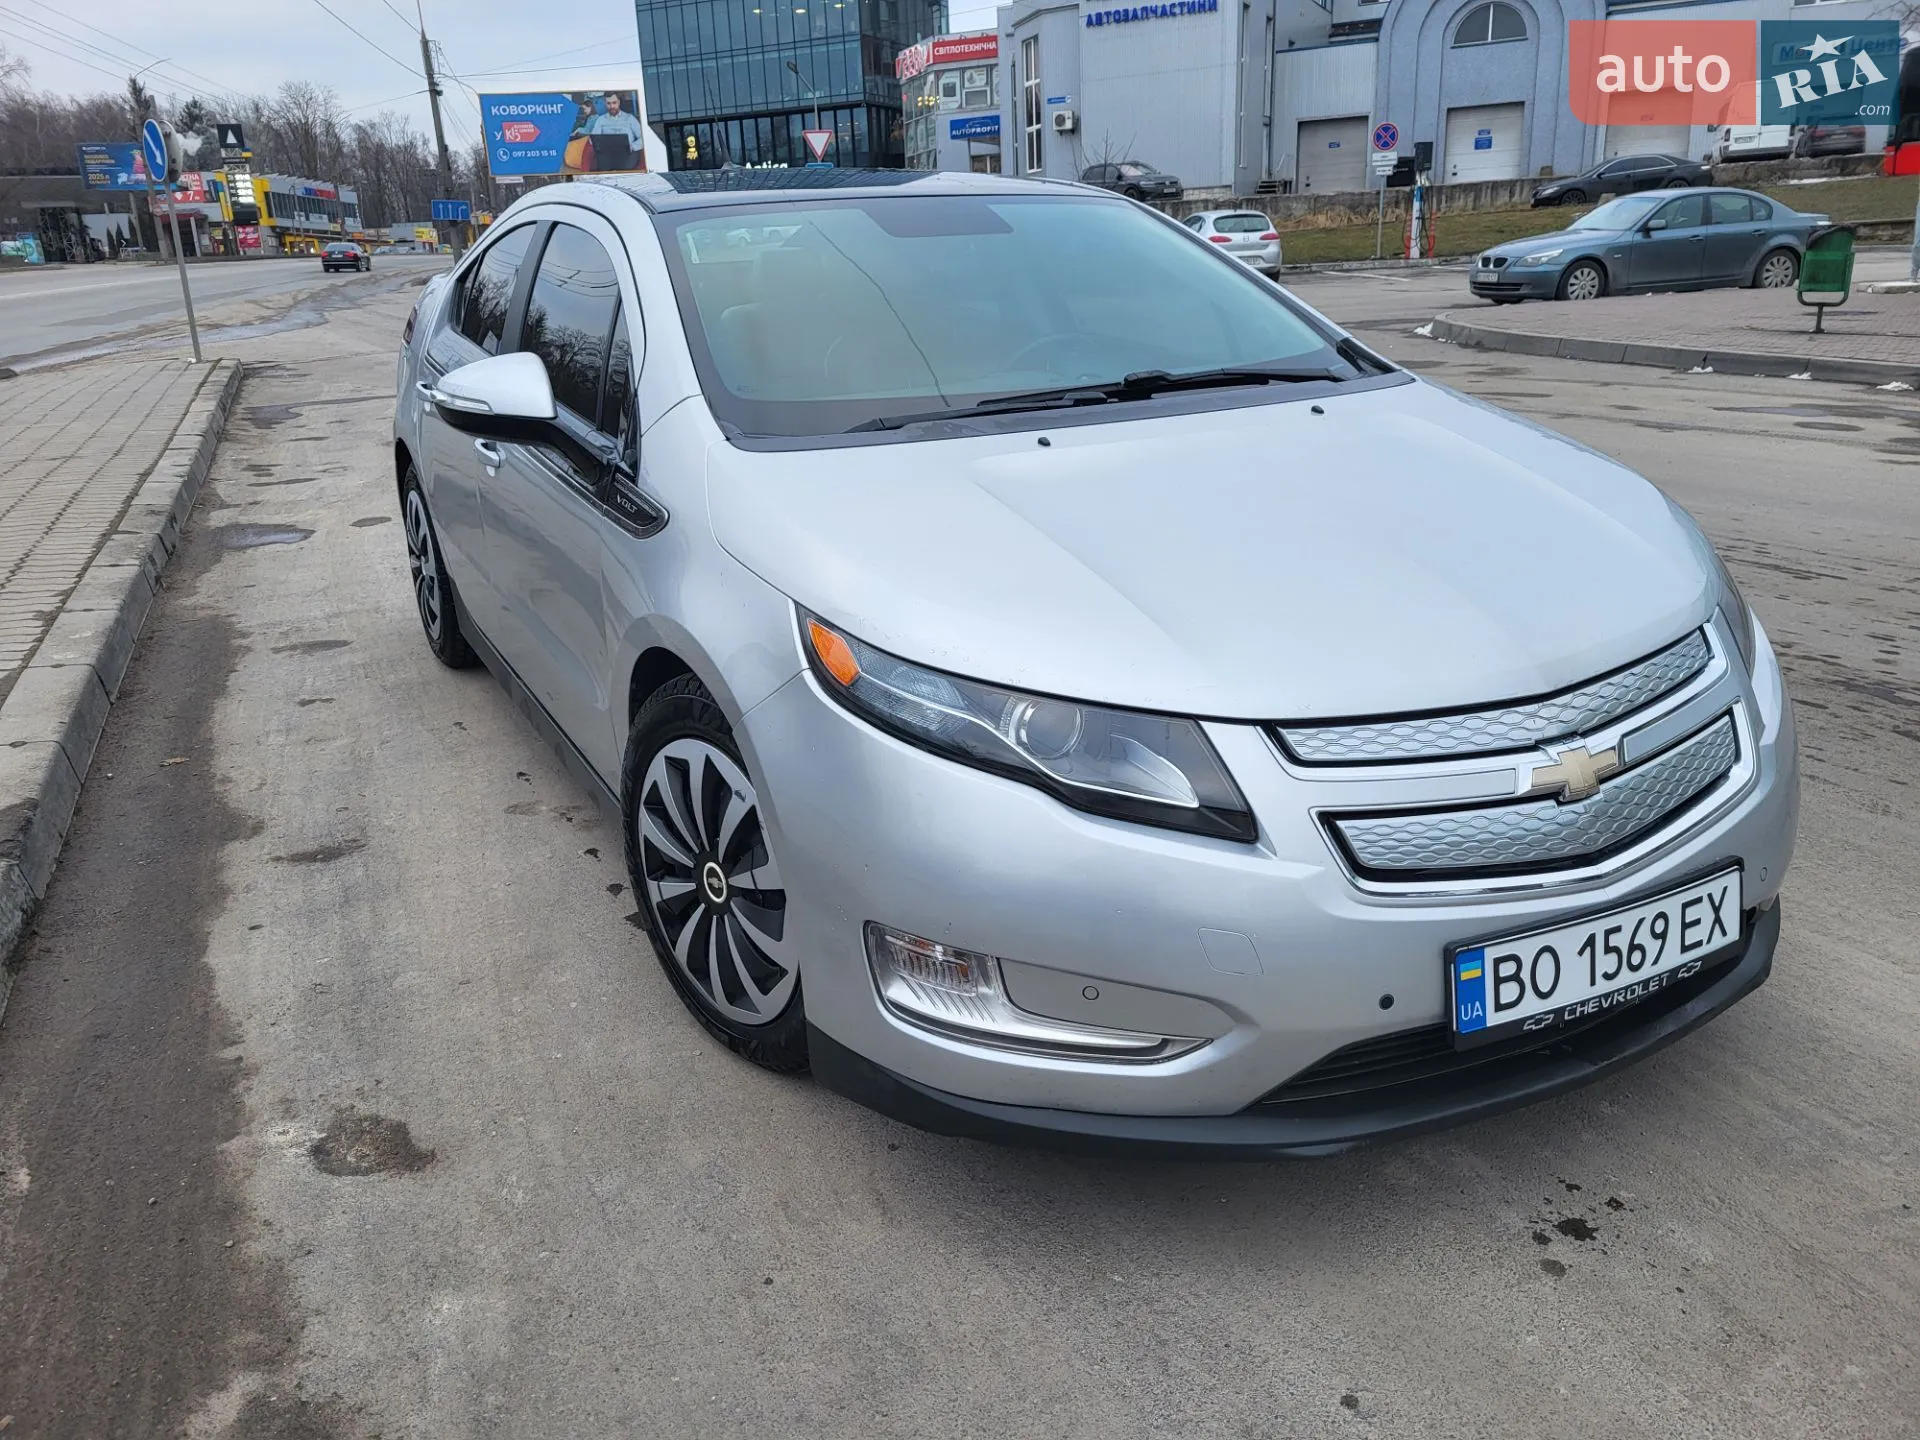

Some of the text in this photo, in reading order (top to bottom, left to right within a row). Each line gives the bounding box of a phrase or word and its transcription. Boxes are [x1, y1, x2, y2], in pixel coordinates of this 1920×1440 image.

[1085, 0, 1218, 28] АВТОЗАПЧАСТИНИ
[934, 41, 997, 56] СВІТЛОТЕХНІЧНА
[491, 104, 564, 116] КОВОРКІНГ
[951, 124, 1000, 136] AUTOPROFIT
[512, 150, 526, 158] 097
[617, 493, 638, 513] VOLT
[1492, 885, 1729, 1013] BO 1569 EX
[1564, 971, 1670, 1020] CHEVROLET
[1461, 1000, 1484, 1021] UA
